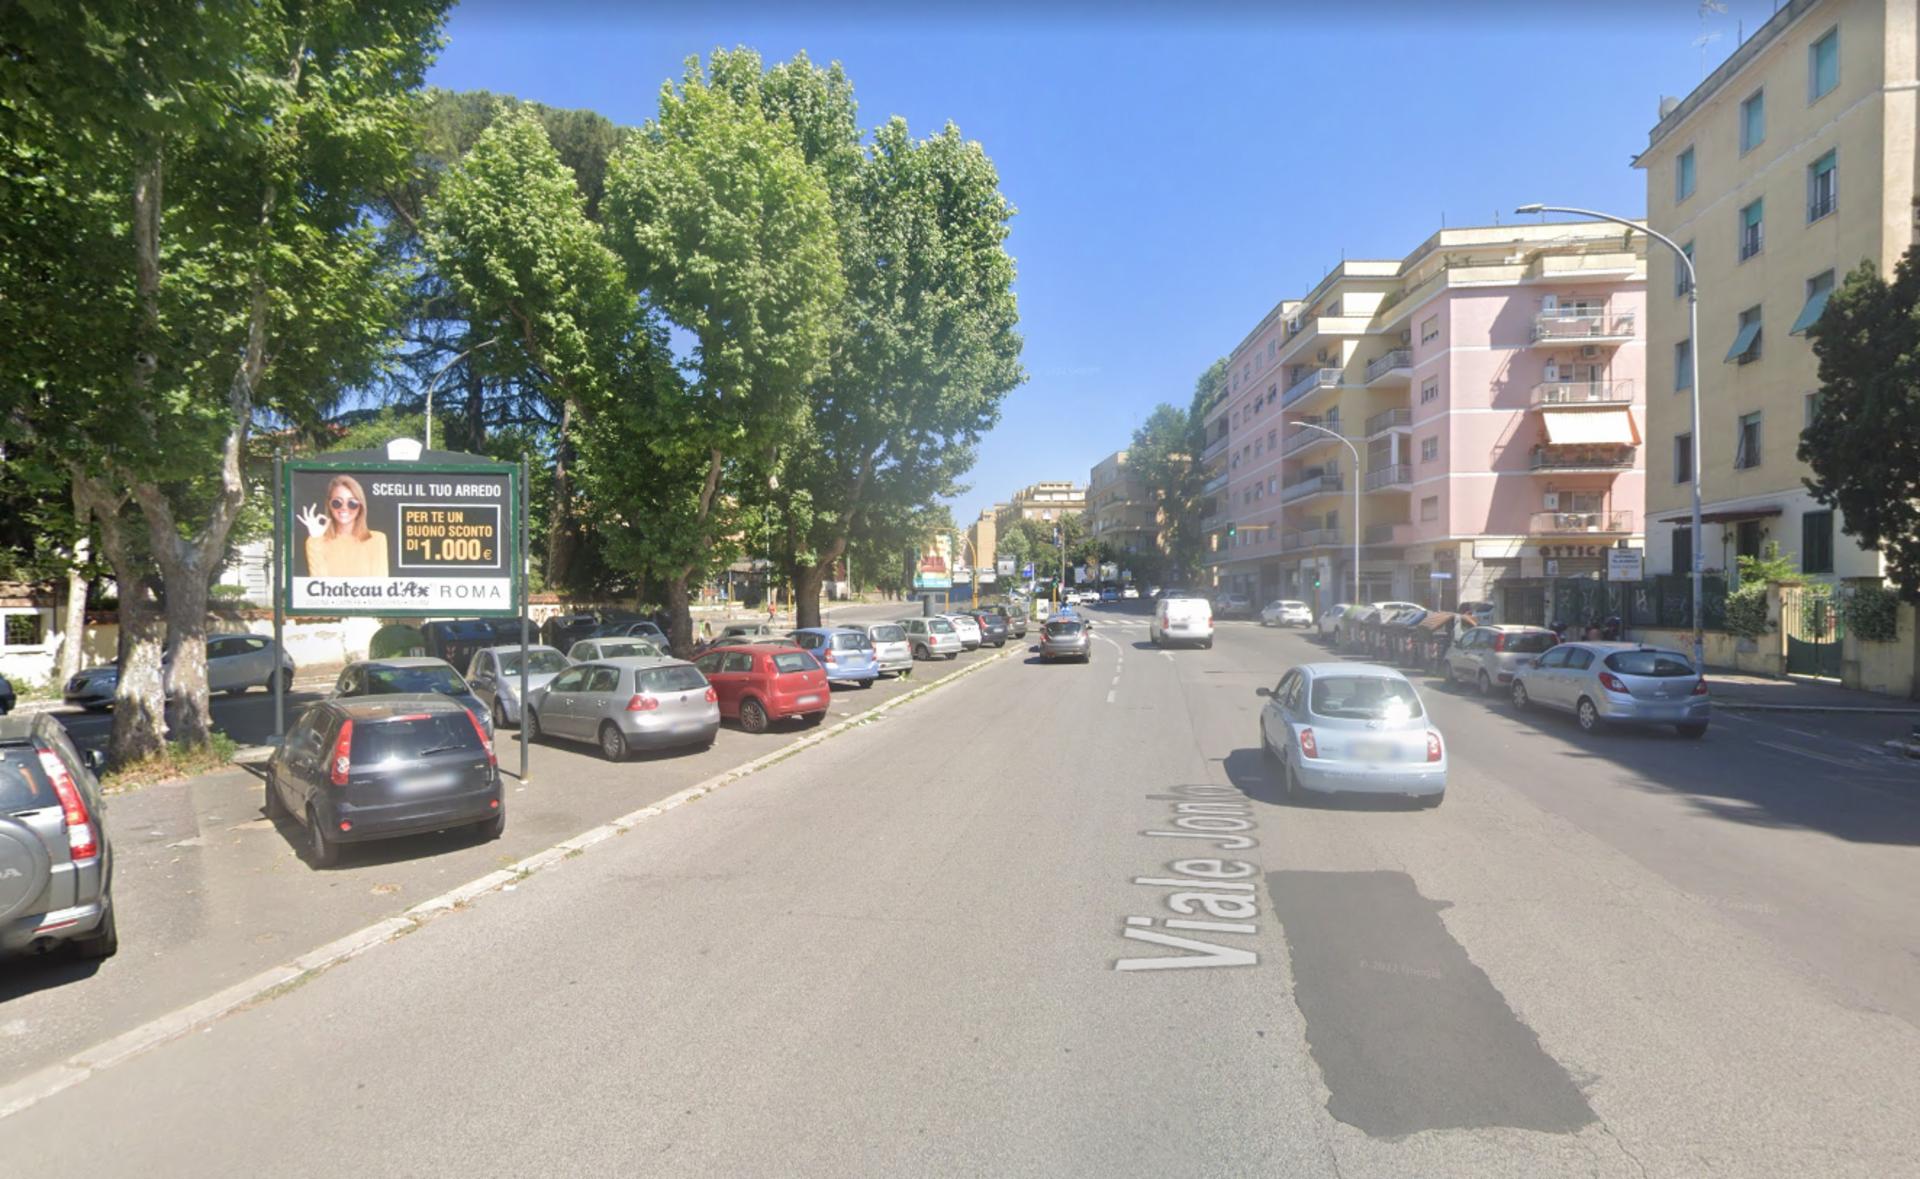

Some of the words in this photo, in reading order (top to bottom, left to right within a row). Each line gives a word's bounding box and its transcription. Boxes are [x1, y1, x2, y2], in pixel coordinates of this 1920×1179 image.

[372, 483, 412, 496] SCEGLI
[415, 484, 426, 496] IL
[429, 484, 452, 496] TUO
[455, 484, 501, 497] ARREDO
[406, 511, 428, 523] PER
[431, 511, 445, 523] TE
[447, 511, 463, 523] UN
[406, 525, 446, 537] BUONO
[448, 525, 493, 537] SCONTO
[406, 539, 418, 551] DI
[420, 539, 481, 560] 1.000
[306, 580, 382, 598] Chateau
[387, 581, 429, 598] d'Ax
[440, 585, 501, 599] ROMA
